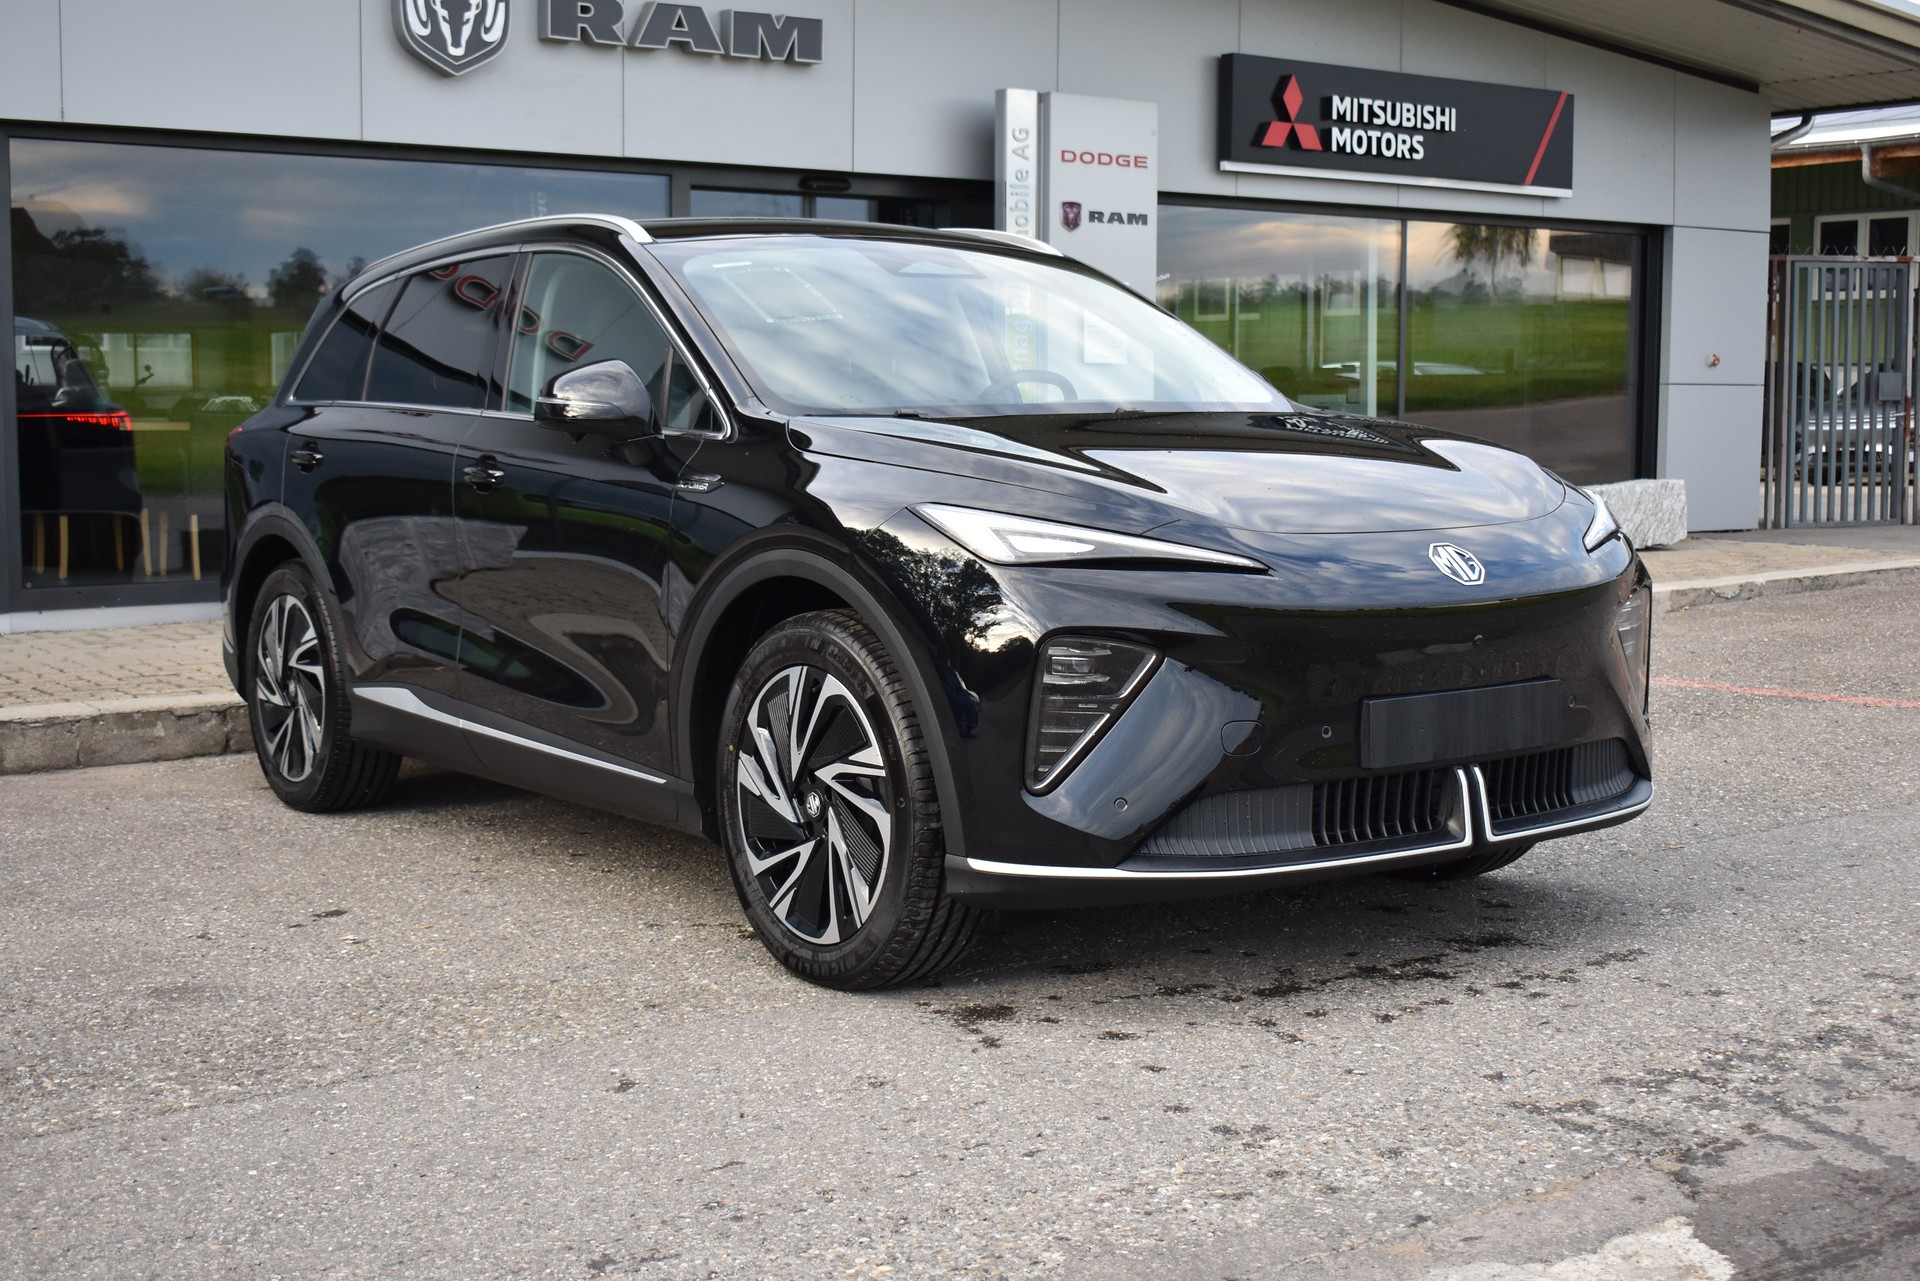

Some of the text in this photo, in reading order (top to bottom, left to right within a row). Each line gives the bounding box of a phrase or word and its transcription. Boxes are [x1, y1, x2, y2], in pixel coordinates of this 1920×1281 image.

[538, 0, 824, 64] RAM
[1331, 95, 1457, 132] MITSUBISHI
[1011, 127, 1029, 161] AG
[1061, 150, 1148, 168] DODGE
[1331, 126, 1425, 160] MOTORS
[1088, 211, 1148, 226] RAM
[1431, 545, 1482, 582] MG
